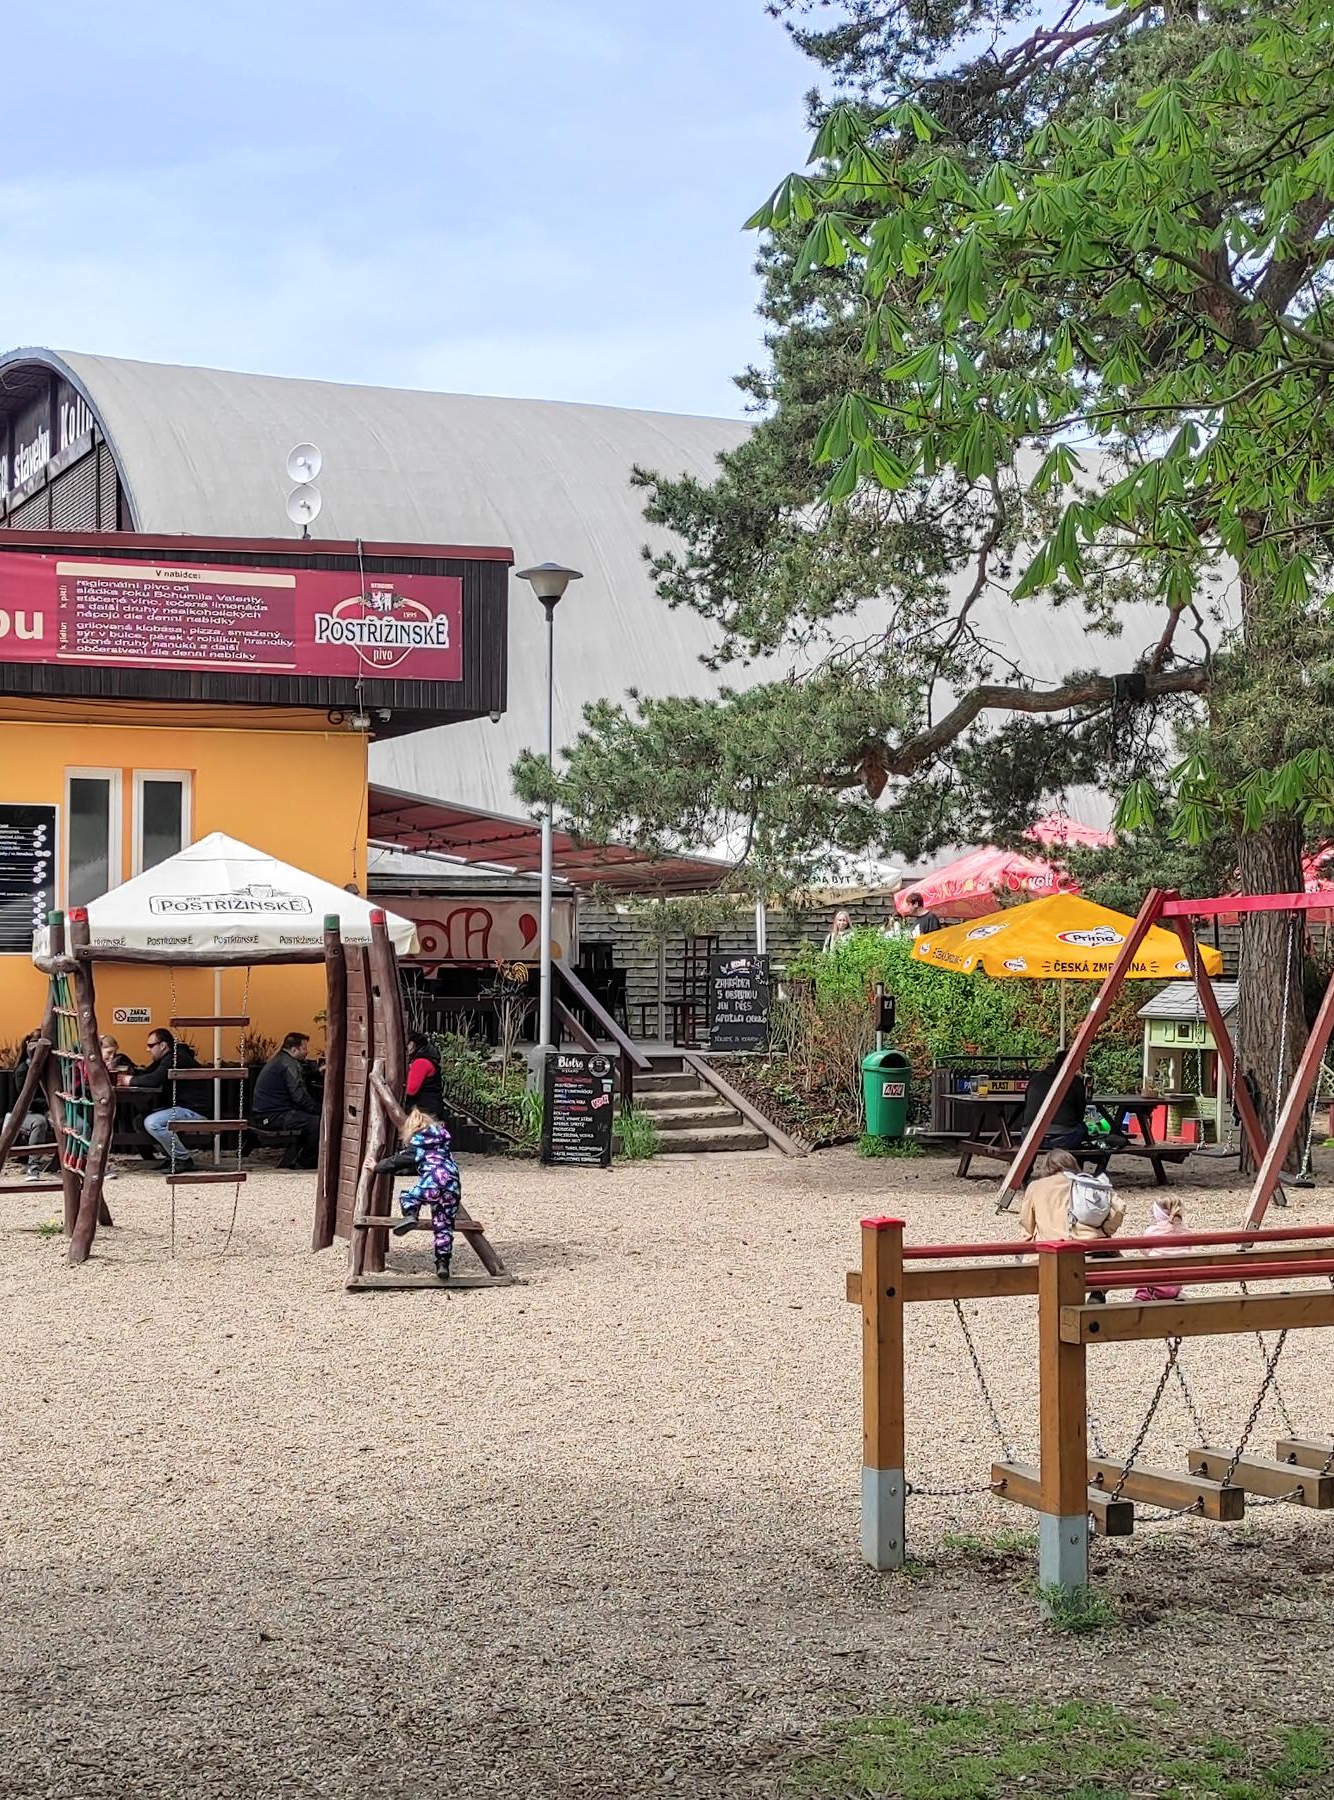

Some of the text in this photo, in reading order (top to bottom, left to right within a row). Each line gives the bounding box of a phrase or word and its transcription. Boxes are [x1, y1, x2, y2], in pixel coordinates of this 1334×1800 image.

[154, 591, 213, 601] Bohumila
[123, 605, 158, 614] druhy
[212, 602, 267, 611] limonáda
[77, 611, 119, 620] nápojů
[147, 613, 181, 621] denní
[186, 616, 235, 626] nabídky
[76, 621, 132, 631] grilovaná
[227, 629, 281, 639] smažený
[318, 615, 446, 645] POSTŘIŽINSKÉ
[115, 639, 148, 647] druhy
[76, 645, 256, 660] občerstvení dle denní nabídky
[373, 647, 392, 663] pivo
[1073, 934, 1115, 943] Prima
[1053, 959, 1089, 972] ČESKÁ
[717, 989, 723, 999] S
[992, 1081, 1009, 1090] PLAST
